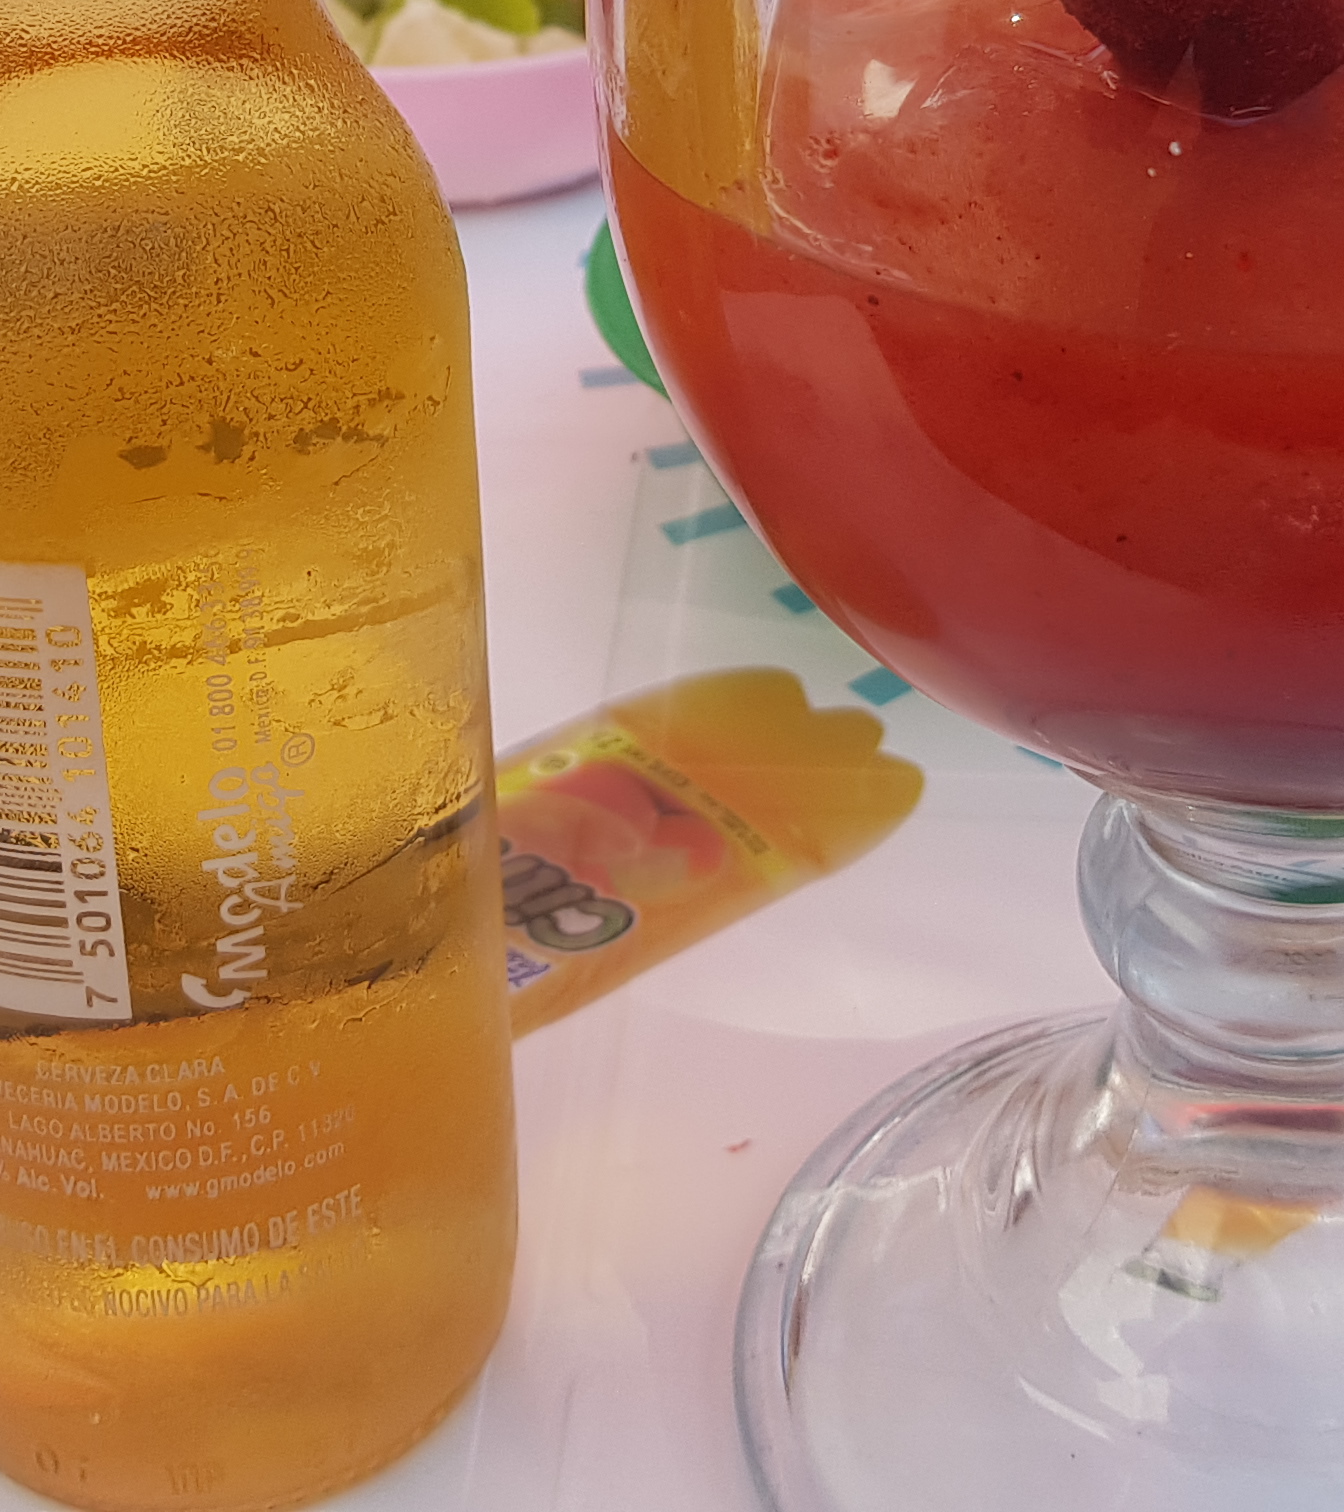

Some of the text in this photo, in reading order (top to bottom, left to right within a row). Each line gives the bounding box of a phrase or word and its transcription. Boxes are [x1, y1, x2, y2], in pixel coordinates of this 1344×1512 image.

[206, 674, 235, 716] 800
[85, 986, 119, 1009] 7
[36, 1056, 225, 1085] CERVEZA CLARA
[8, 1110, 64, 1139] LAGO
[70, 1121, 177, 1143] ALBERTO
[233, 1105, 272, 1131] 156
[60, 1174, 105, 1200] Vol.
[146, 1141, 346, 1201] www.gmodelo.com
[101, 1148, 192, 1173] MEXICO
[131, 1222, 260, 1268] CONSUMO
[268, 1210, 299, 1249] DE
[104, 1286, 188, 1318] NOCIVO
